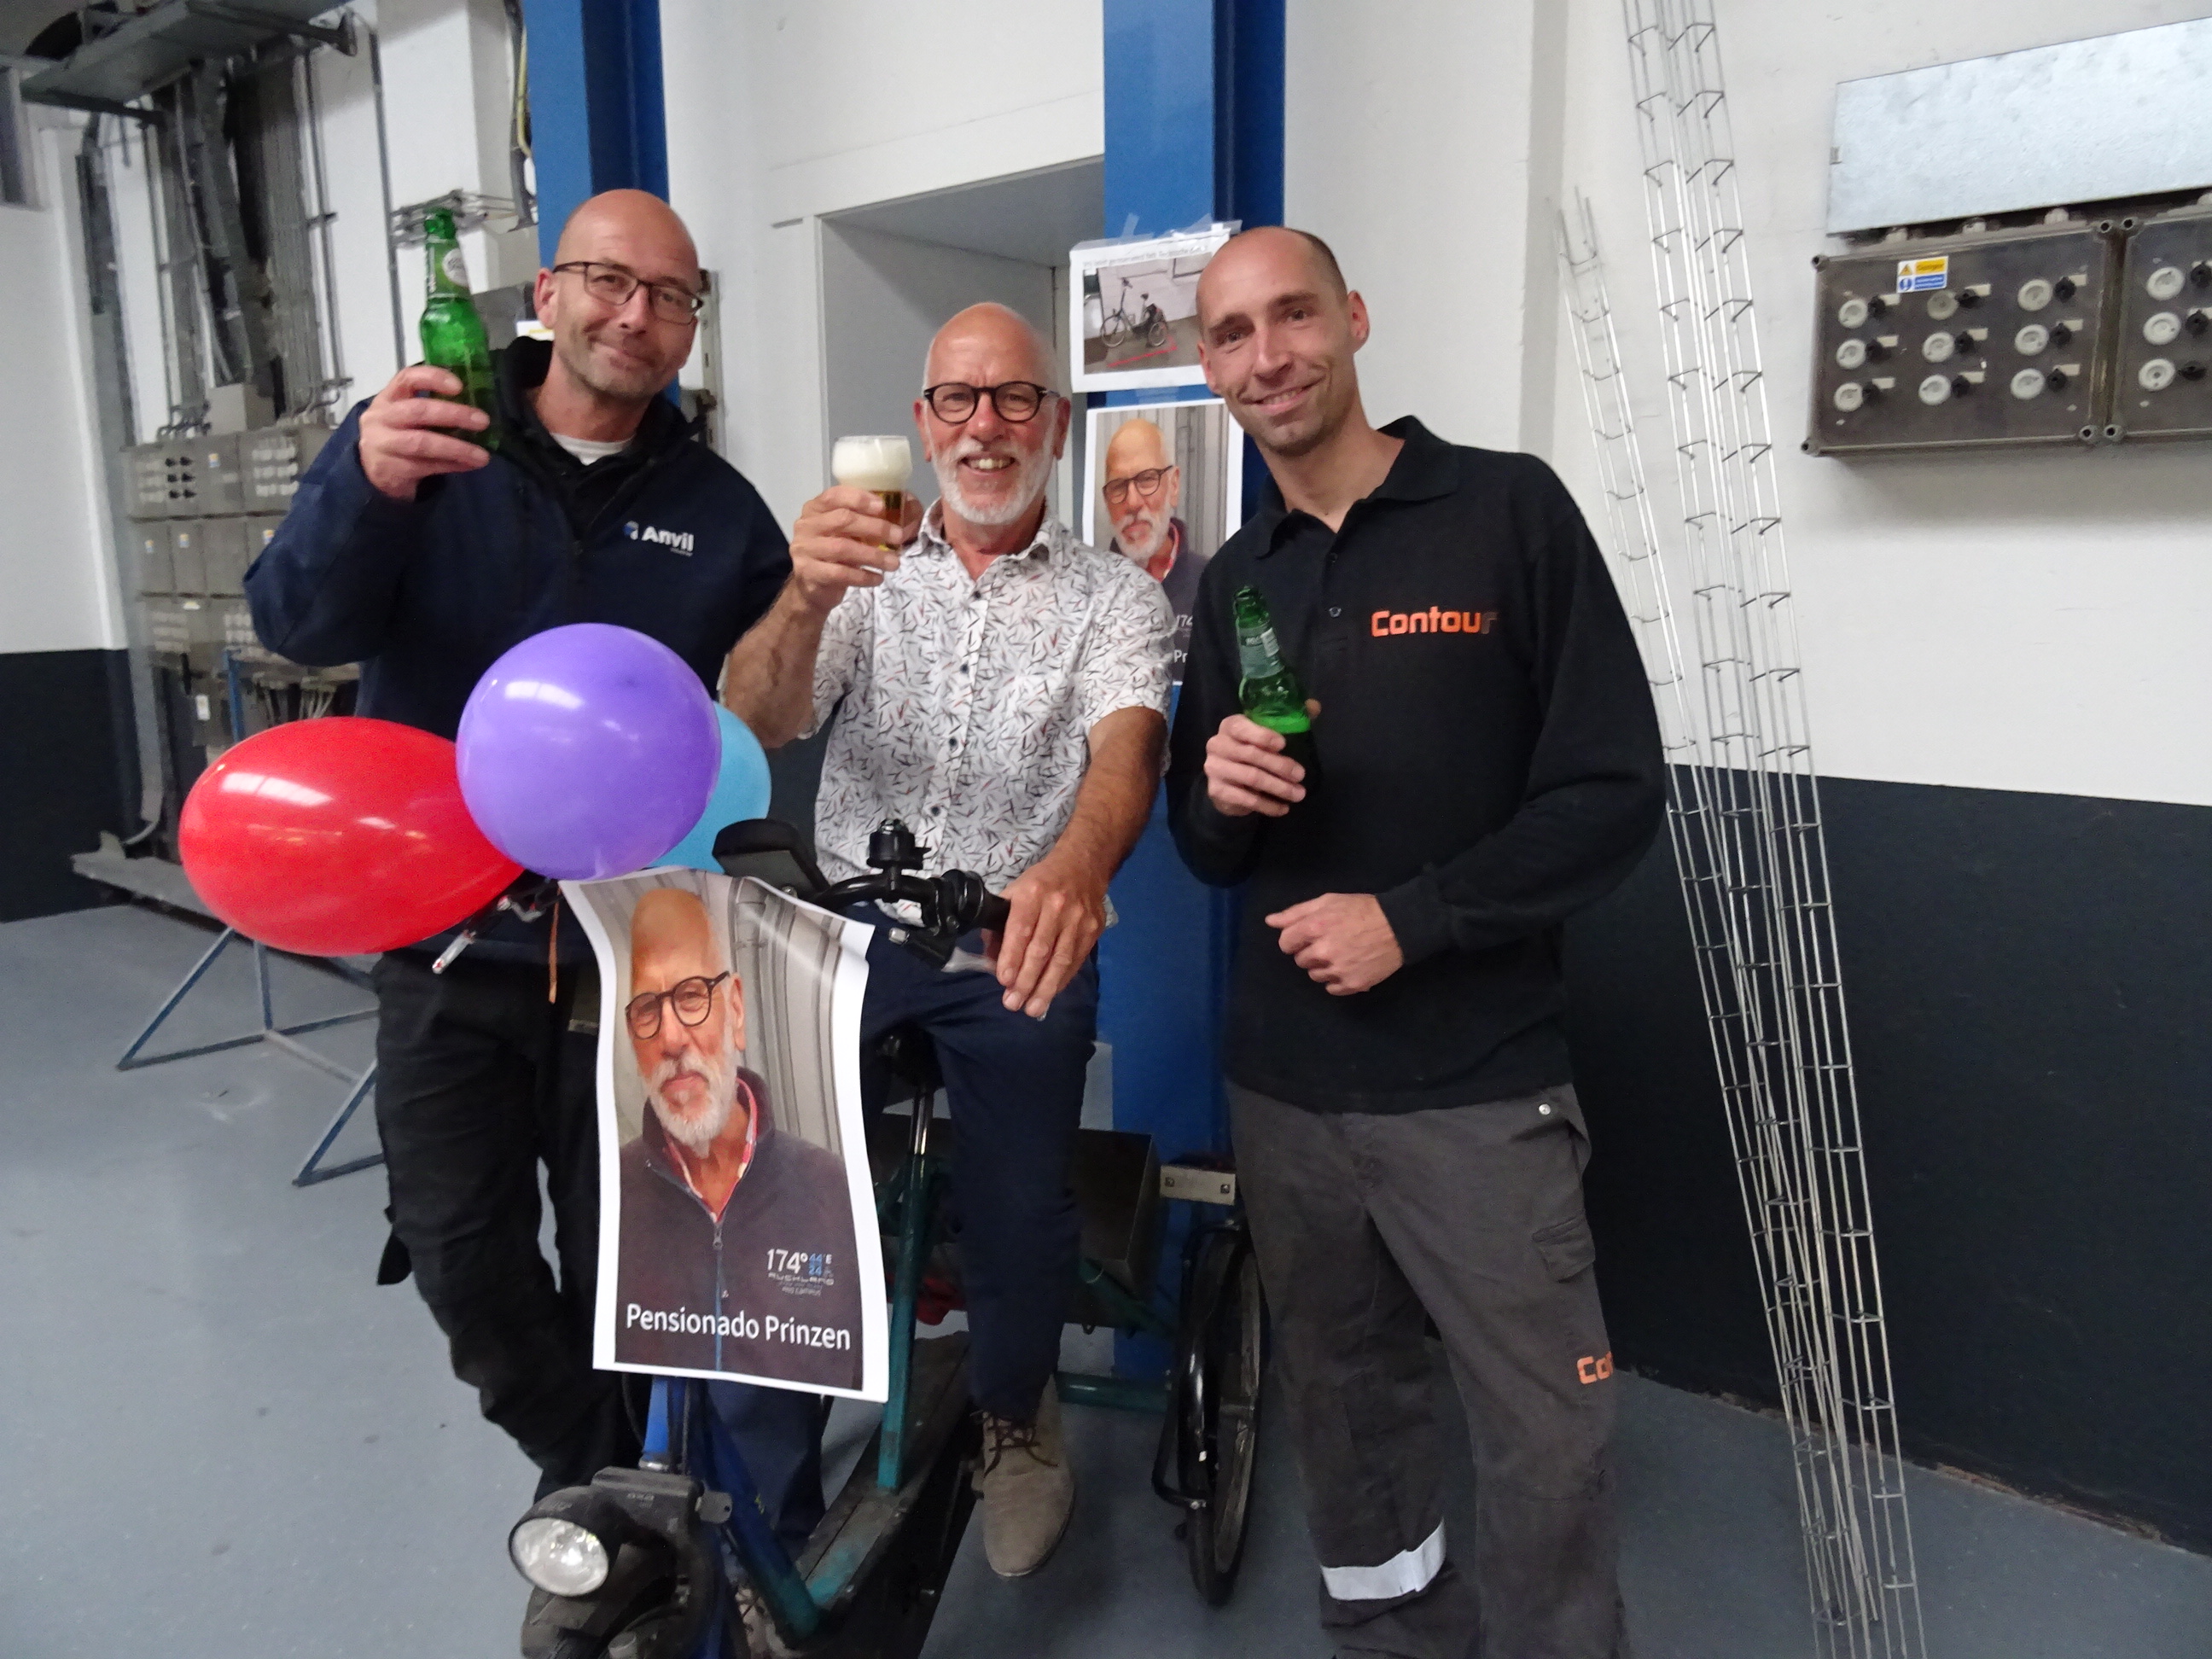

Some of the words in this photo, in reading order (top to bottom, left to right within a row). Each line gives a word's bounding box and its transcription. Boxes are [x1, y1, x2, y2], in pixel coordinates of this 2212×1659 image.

[641, 526, 694, 552] Anvil
[1371, 605, 1499, 637] Contour
[626, 1303, 760, 1340] Pensionado
[765, 1315, 851, 1351] Prinzen
[1576, 1350, 1613, 1385] Co
